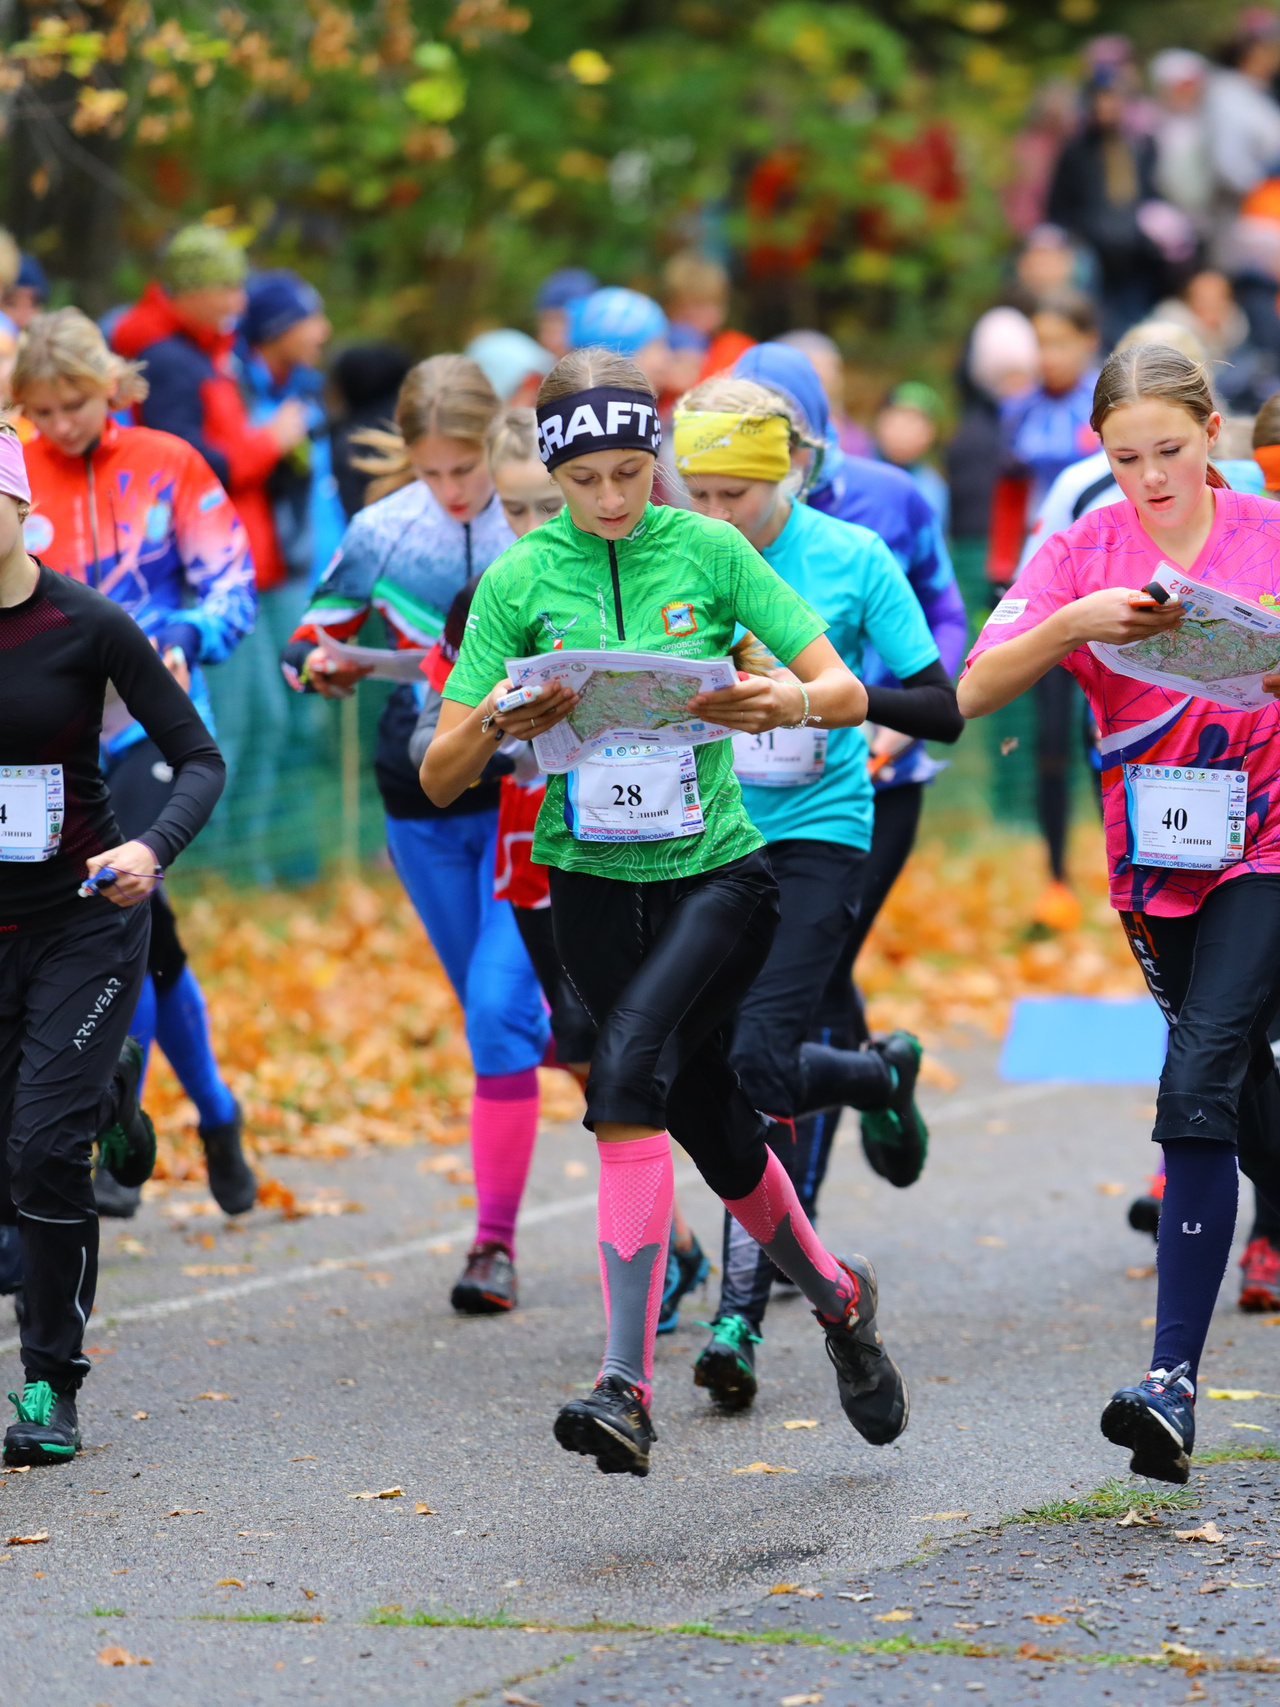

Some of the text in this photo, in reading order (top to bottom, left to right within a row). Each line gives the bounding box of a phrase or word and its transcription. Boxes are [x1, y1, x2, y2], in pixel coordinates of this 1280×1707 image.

[538, 401, 653, 462] CRAFT
[661, 639, 705, 651] ОРЛОВСКАЯ
[750, 732, 774, 751] 31
[611, 784, 642, 807] 28
[628, 810, 634, 819] 2
[637, 809, 669, 819] линия
[1161, 807, 1188, 831] 40
[626, 831, 675, 841] СОРЕВНОВАНИЯ
[1171, 835, 1177, 844] 2
[1179, 837, 1212, 846] линия
[1167, 860, 1212, 869] СОРЕВНОВАНИЯ
